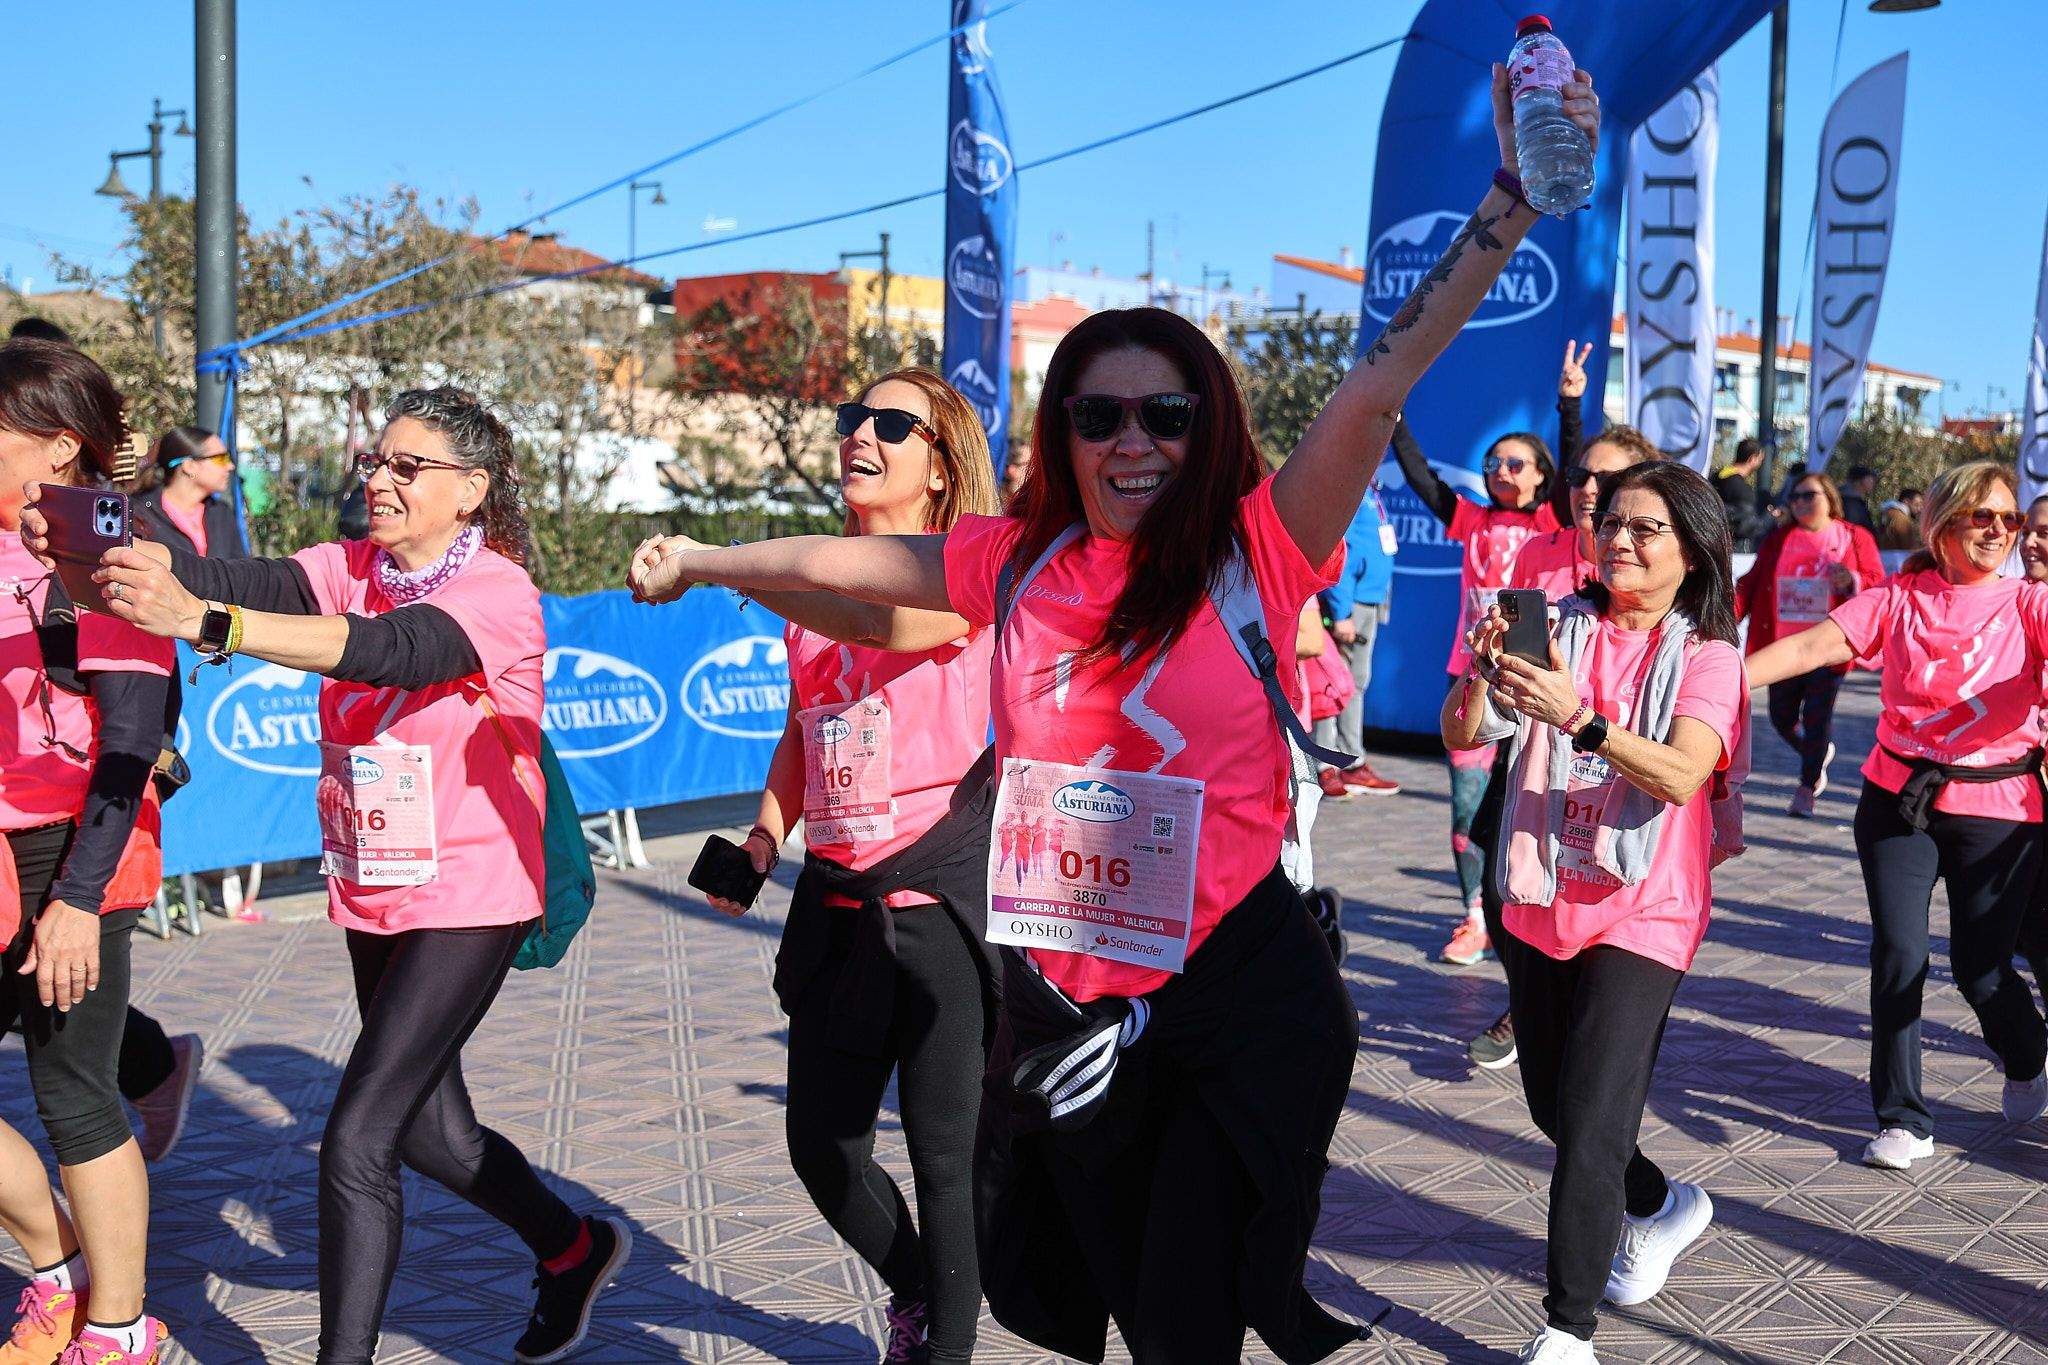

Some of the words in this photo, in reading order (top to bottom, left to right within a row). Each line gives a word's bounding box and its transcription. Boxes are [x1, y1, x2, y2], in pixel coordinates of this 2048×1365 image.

[1638, 84, 1704, 457] OYSHO
[1815, 136, 1892, 453] OYSHO
[1013, 794, 1045, 809] SUMA
[1058, 792, 1130, 816] ASTURIANA
[843, 823, 878, 834] Santander
[1568, 825, 1593, 839] 2986
[354, 837, 367, 847] 25
[1565, 836, 1574, 845] LA
[1575, 839, 1593, 850] MUJE
[374, 867, 420, 877] Santander
[1059, 850, 1131, 888] 016
[1563, 867, 1578, 881] LA
[1072, 889, 1107, 907] 3870
[1013, 901, 1056, 914] CARRERA
[1058, 904, 1071, 915] DE
[1072, 906, 1084, 918] LA
[1085, 909, 1116, 923] MUJER
[1122, 916, 1165, 932] VALENCIA
[1010, 920, 1073, 940] OYSHO
[1109, 936, 1165, 957] Santander
